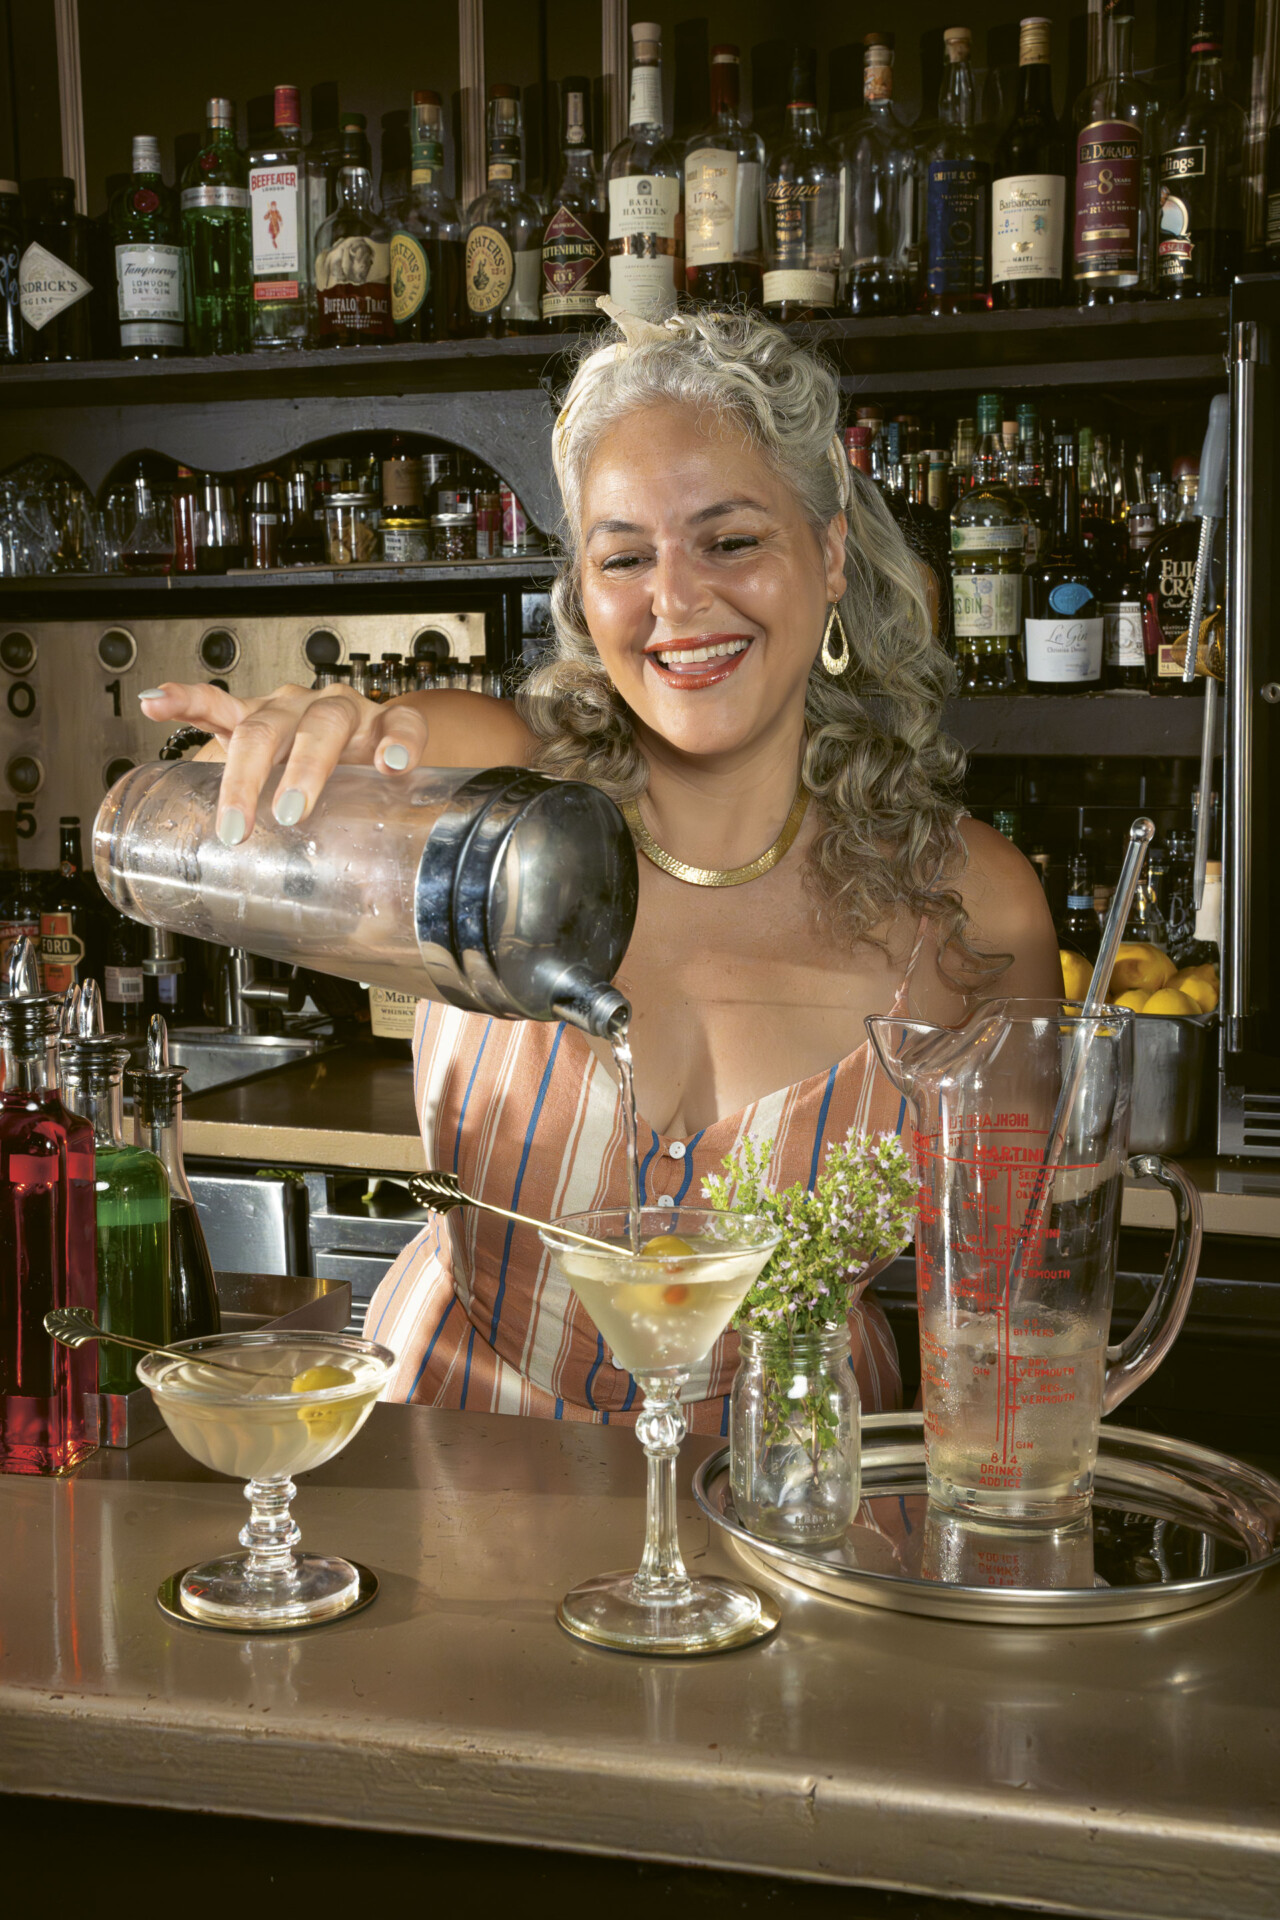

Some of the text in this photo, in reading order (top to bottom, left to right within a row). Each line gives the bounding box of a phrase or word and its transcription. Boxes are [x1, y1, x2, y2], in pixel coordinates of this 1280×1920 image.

[1092, 145, 1136, 160] DORADO
[1161, 156, 1195, 174] lings
[251, 172, 297, 191] BEEFEATER
[1098, 168, 1113, 195] 8
[1000, 198, 1051, 211] Barbancourt
[623, 207, 667, 216] HAYDEN
[21, 280, 78, 296] NDRICK'S
[323, 296, 356, 315] BUFFALO
[1161, 559, 1198, 580] ELIJA
[1159, 577, 1195, 598] CRA
[964, 597, 982, 614] GIN
[1045, 623, 1088, 647] Le Gin
[8, 679, 122, 718] 0 1
[15, 802, 37, 839] 5
[42, 938, 70, 954] FORO
[973, 1144, 1044, 1163] MARTINI
[1018, 1170, 1050, 1181] SERVE
[1018, 1181, 1045, 1190] WITH
[1015, 1190, 1046, 1200] OLIVE
[1011, 1228, 1060, 1239] MARTINI
[1022, 1259, 1043, 1267] DRY
[1013, 1269, 1071, 1280] VERMOUTH
[1028, 1358, 1049, 1367] DRY
[972, 1366, 990, 1376] GIN
[1019, 1366, 1075, 1378] VERMOUTH
[1020, 1392, 1075, 1405] VERMOUTH
[1015, 1441, 1034, 1450] GIN
[990, 1452, 1018, 1464] 8 4
[980, 1463, 1023, 1477] DRINKS
[978, 1476, 1022, 1488] ADD ICE
